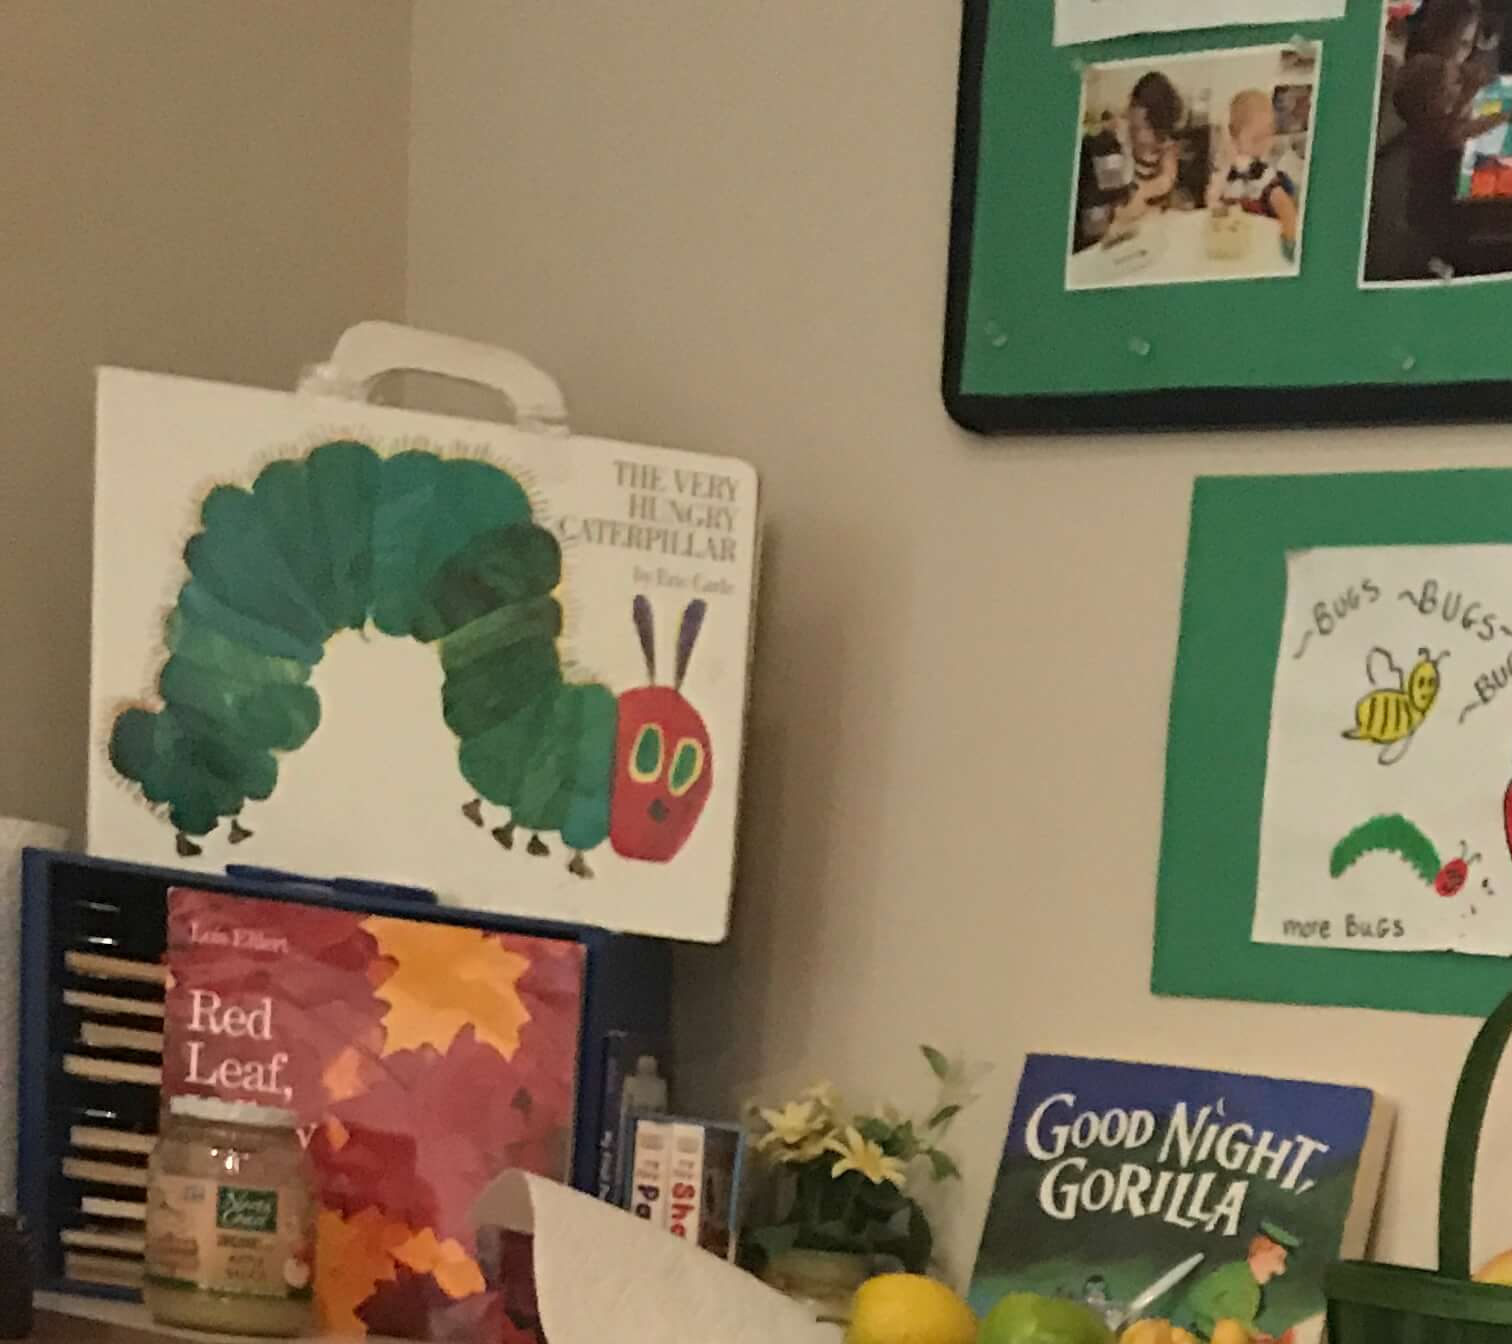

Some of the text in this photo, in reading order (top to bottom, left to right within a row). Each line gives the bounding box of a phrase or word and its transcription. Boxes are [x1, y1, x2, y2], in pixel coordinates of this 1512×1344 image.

[613, 459, 738, 502] THE VERY
[558, 513, 737, 562] CATERPILLAR
[629, 493, 738, 532] HUNGRY
[1282, 919, 1332, 939] more
[187, 989, 273, 1041] Red
[184, 1041, 293, 1101] Leaf,
[1025, 1093, 1156, 1161] GOOD
[1039, 1157, 1250, 1236] GORILLA
